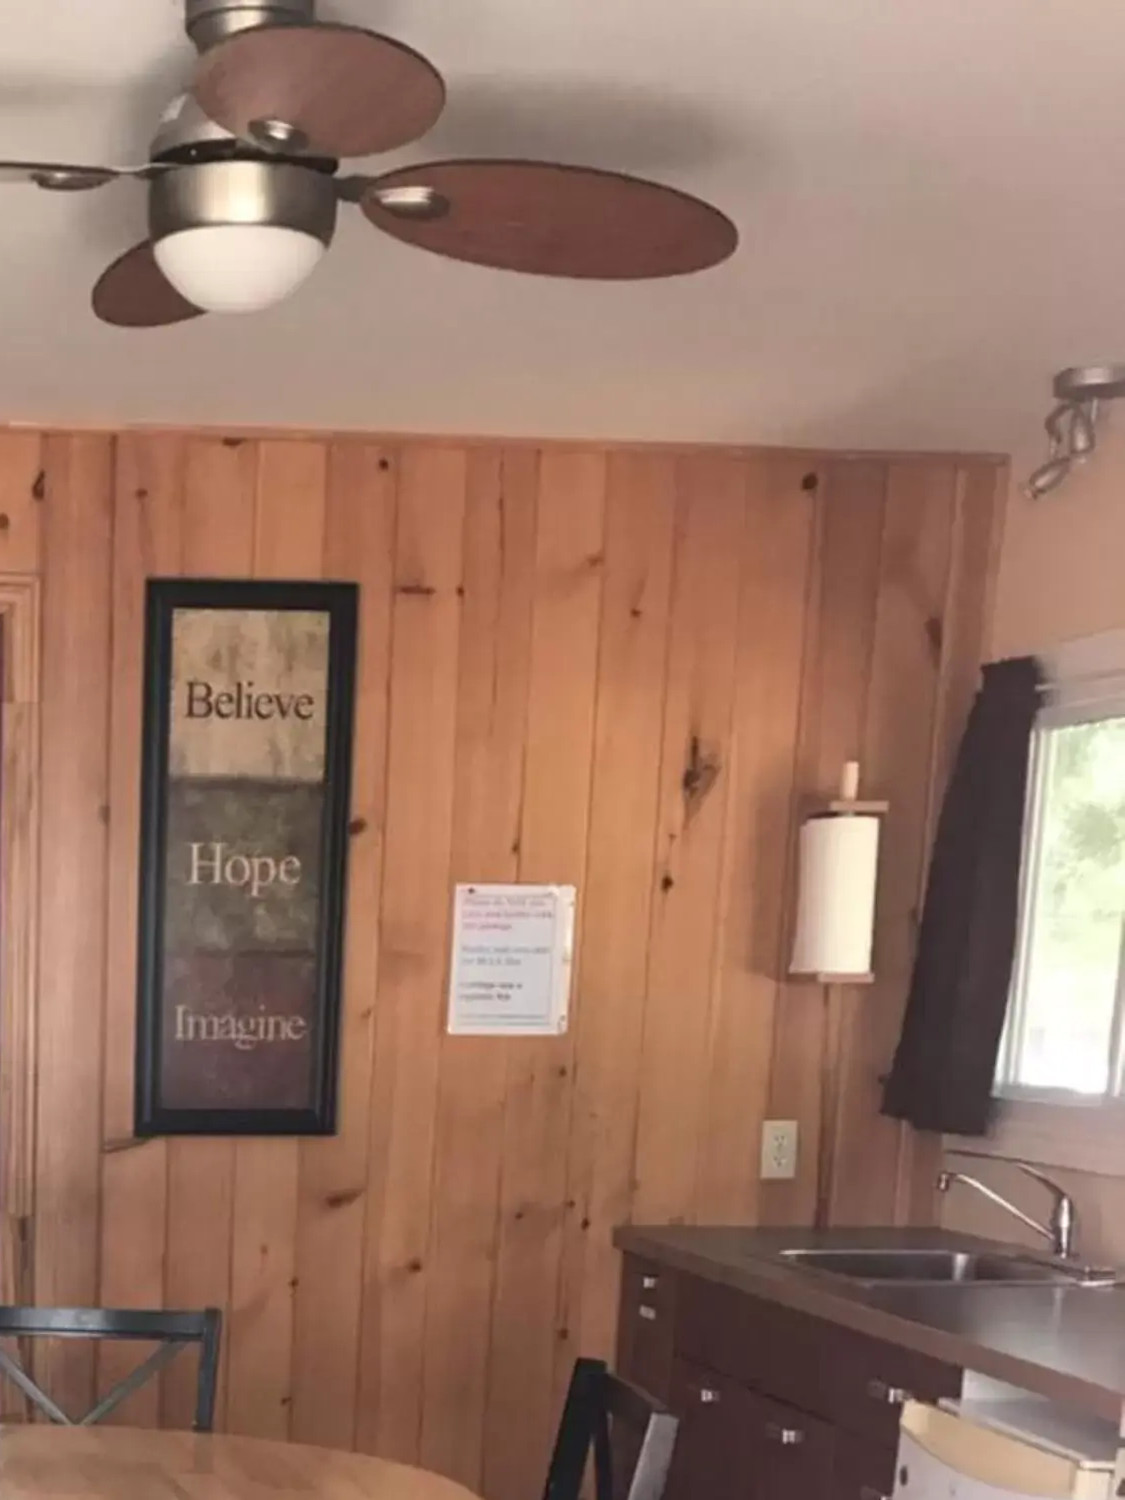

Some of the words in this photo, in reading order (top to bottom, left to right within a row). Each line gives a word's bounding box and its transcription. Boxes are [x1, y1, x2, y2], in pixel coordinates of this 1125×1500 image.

[185, 681, 314, 720] Believe
[187, 842, 302, 898] Hope
[174, 1004, 307, 1049] Imagine
